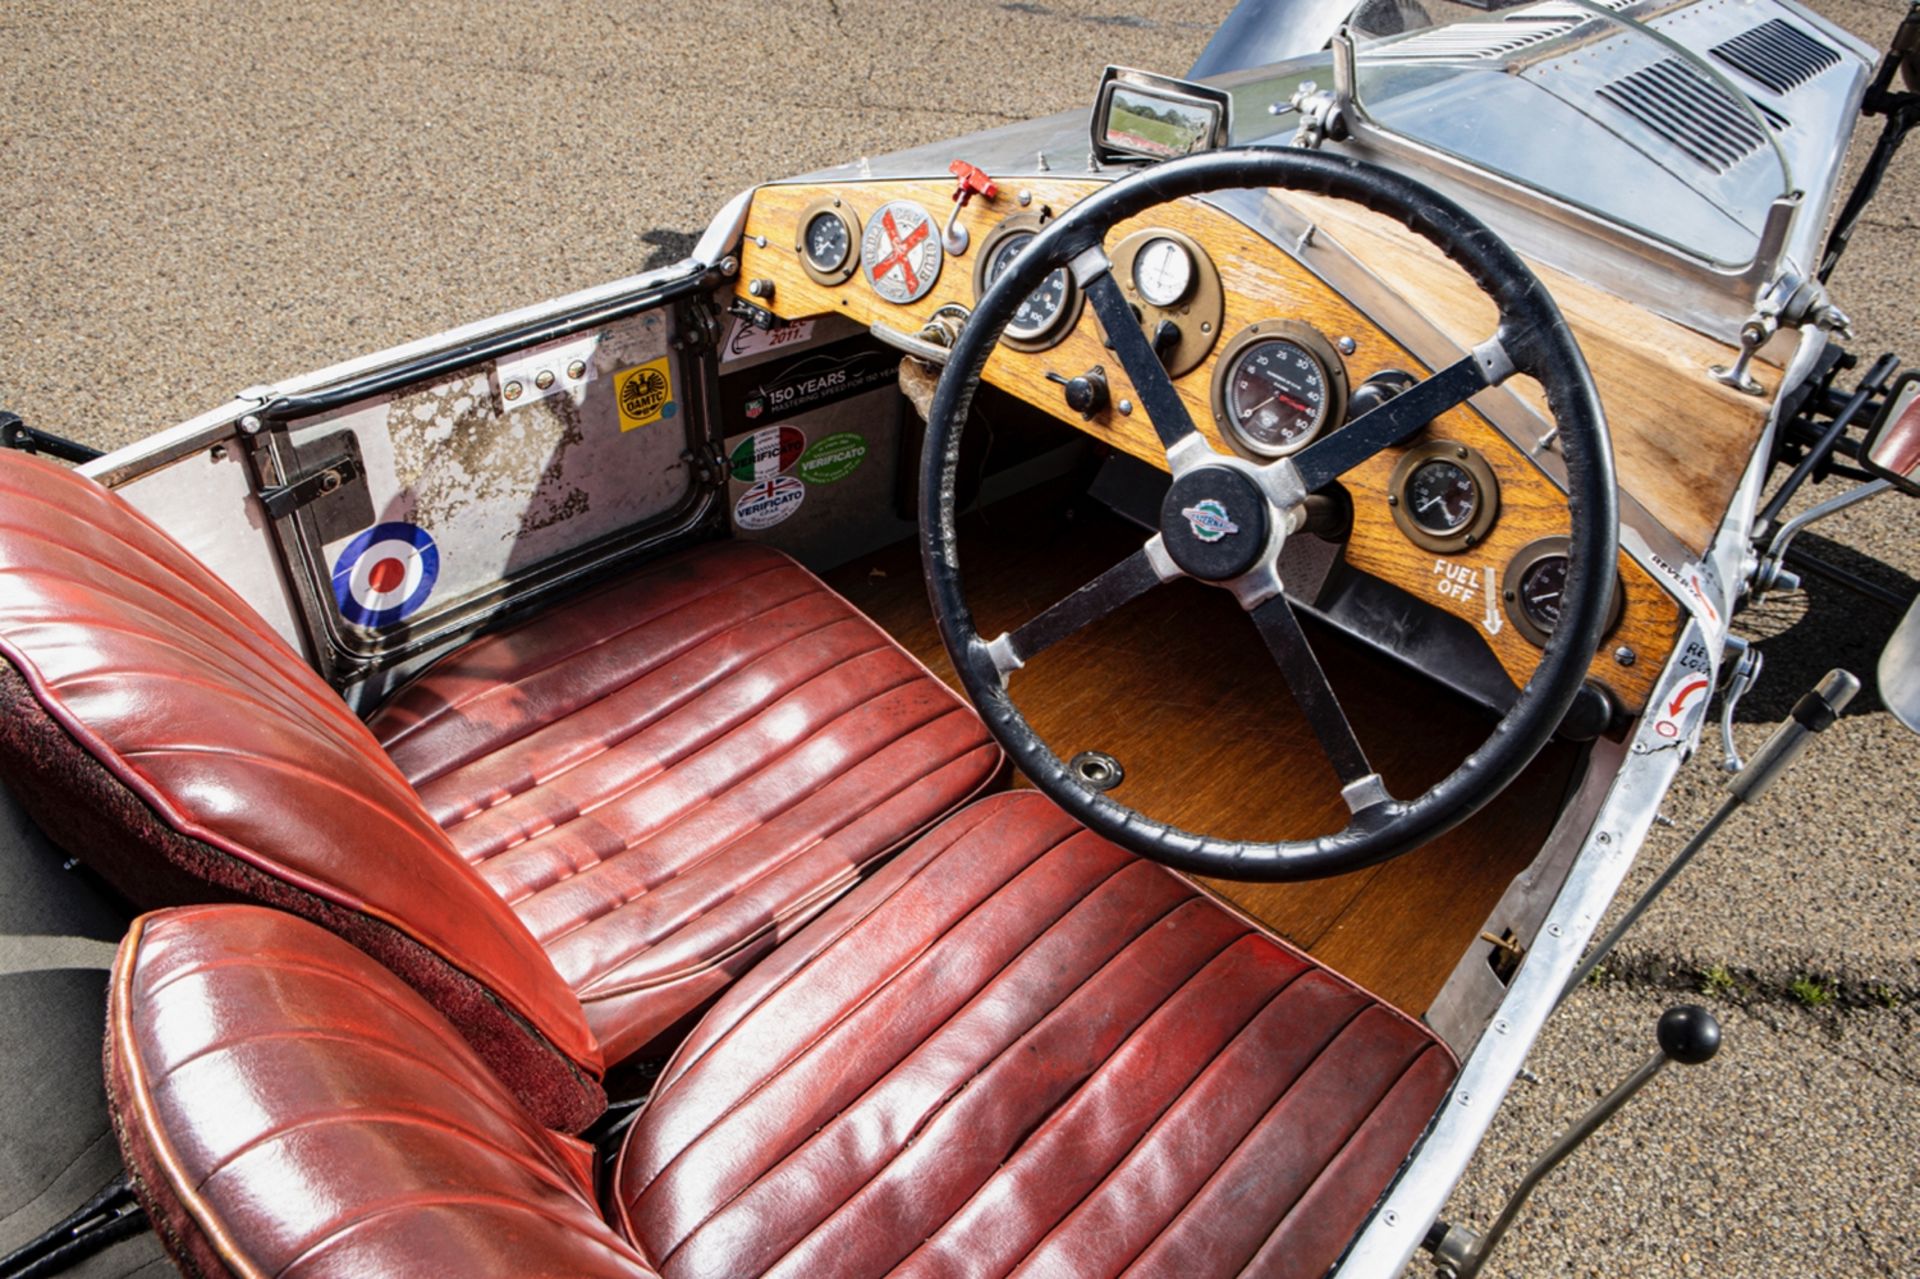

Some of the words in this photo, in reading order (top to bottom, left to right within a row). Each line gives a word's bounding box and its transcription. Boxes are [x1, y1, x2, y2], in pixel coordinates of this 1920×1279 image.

[1030, 311, 1043, 321] 100
[1256, 355, 1269, 365] 20
[1276, 350, 1287, 360] 25
[1296, 359, 1309, 370] 30
[1306, 375, 1316, 386] 35
[769, 387, 794, 405] 150
[797, 370, 847, 395] YEARS
[1307, 391, 1319, 402] 40
[802, 446, 865, 471] VERIFICATO
[737, 490, 802, 518] VERIFICATO
[1433, 559, 1479, 589] FUEL
[1437, 579, 1476, 602] OFF
